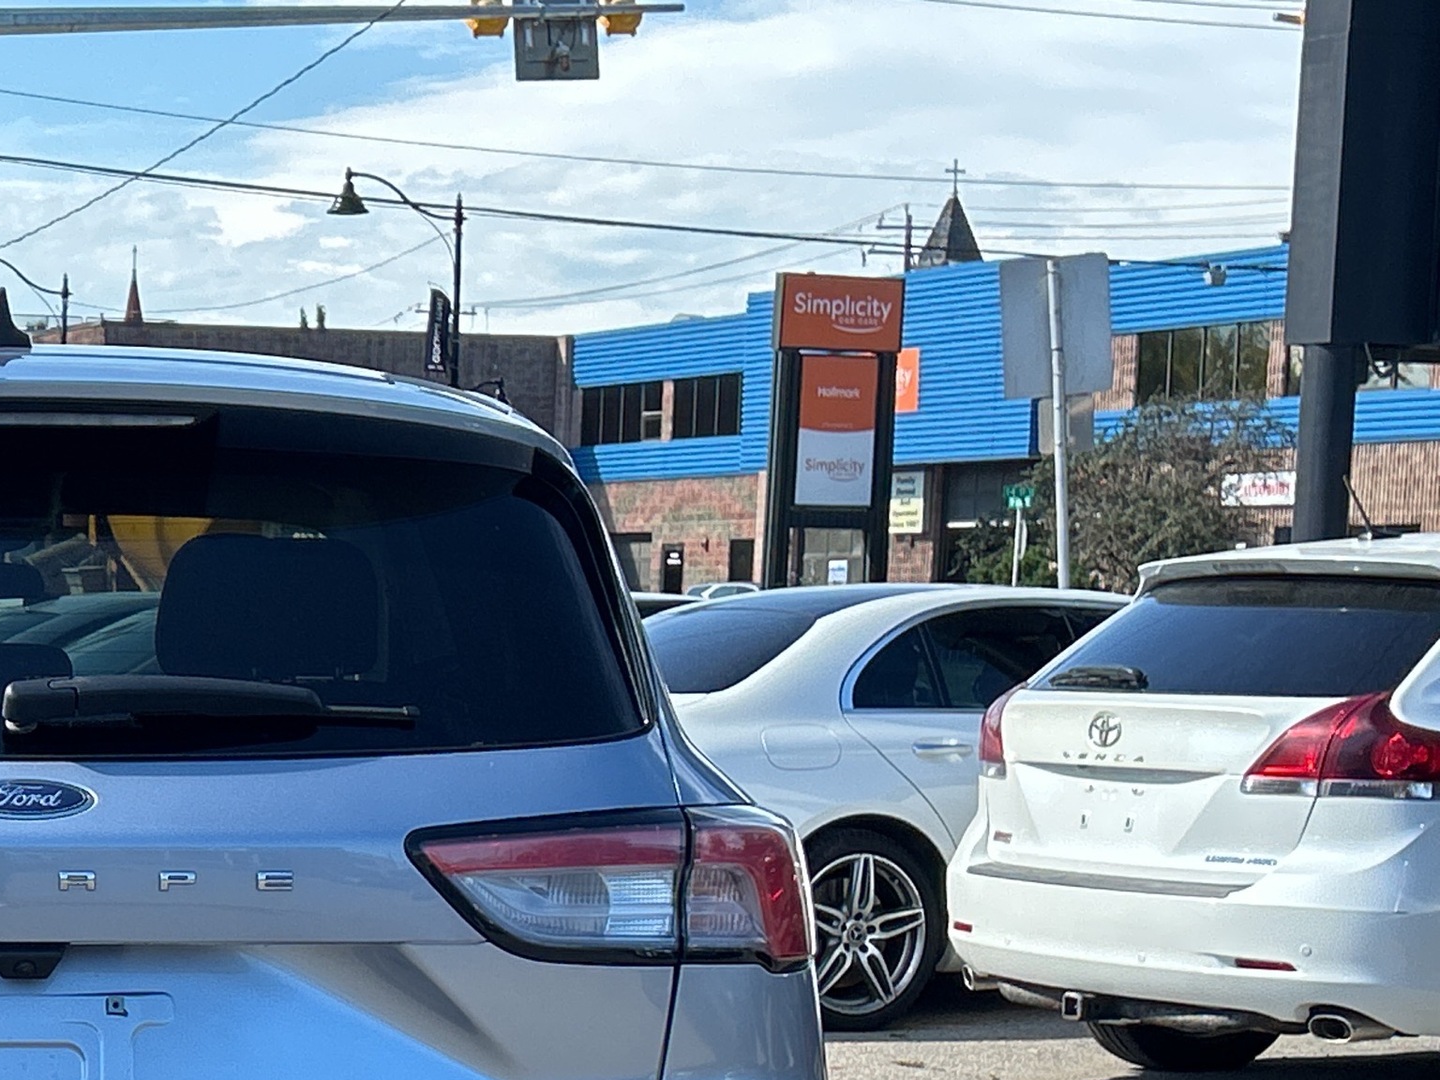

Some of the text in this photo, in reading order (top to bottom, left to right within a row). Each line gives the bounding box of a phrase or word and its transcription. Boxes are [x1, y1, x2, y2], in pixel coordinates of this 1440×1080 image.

[793, 291, 892, 324] Simplicity
[817, 386, 861, 399] Hallmark
[804, 457, 866, 477] Simplicity
